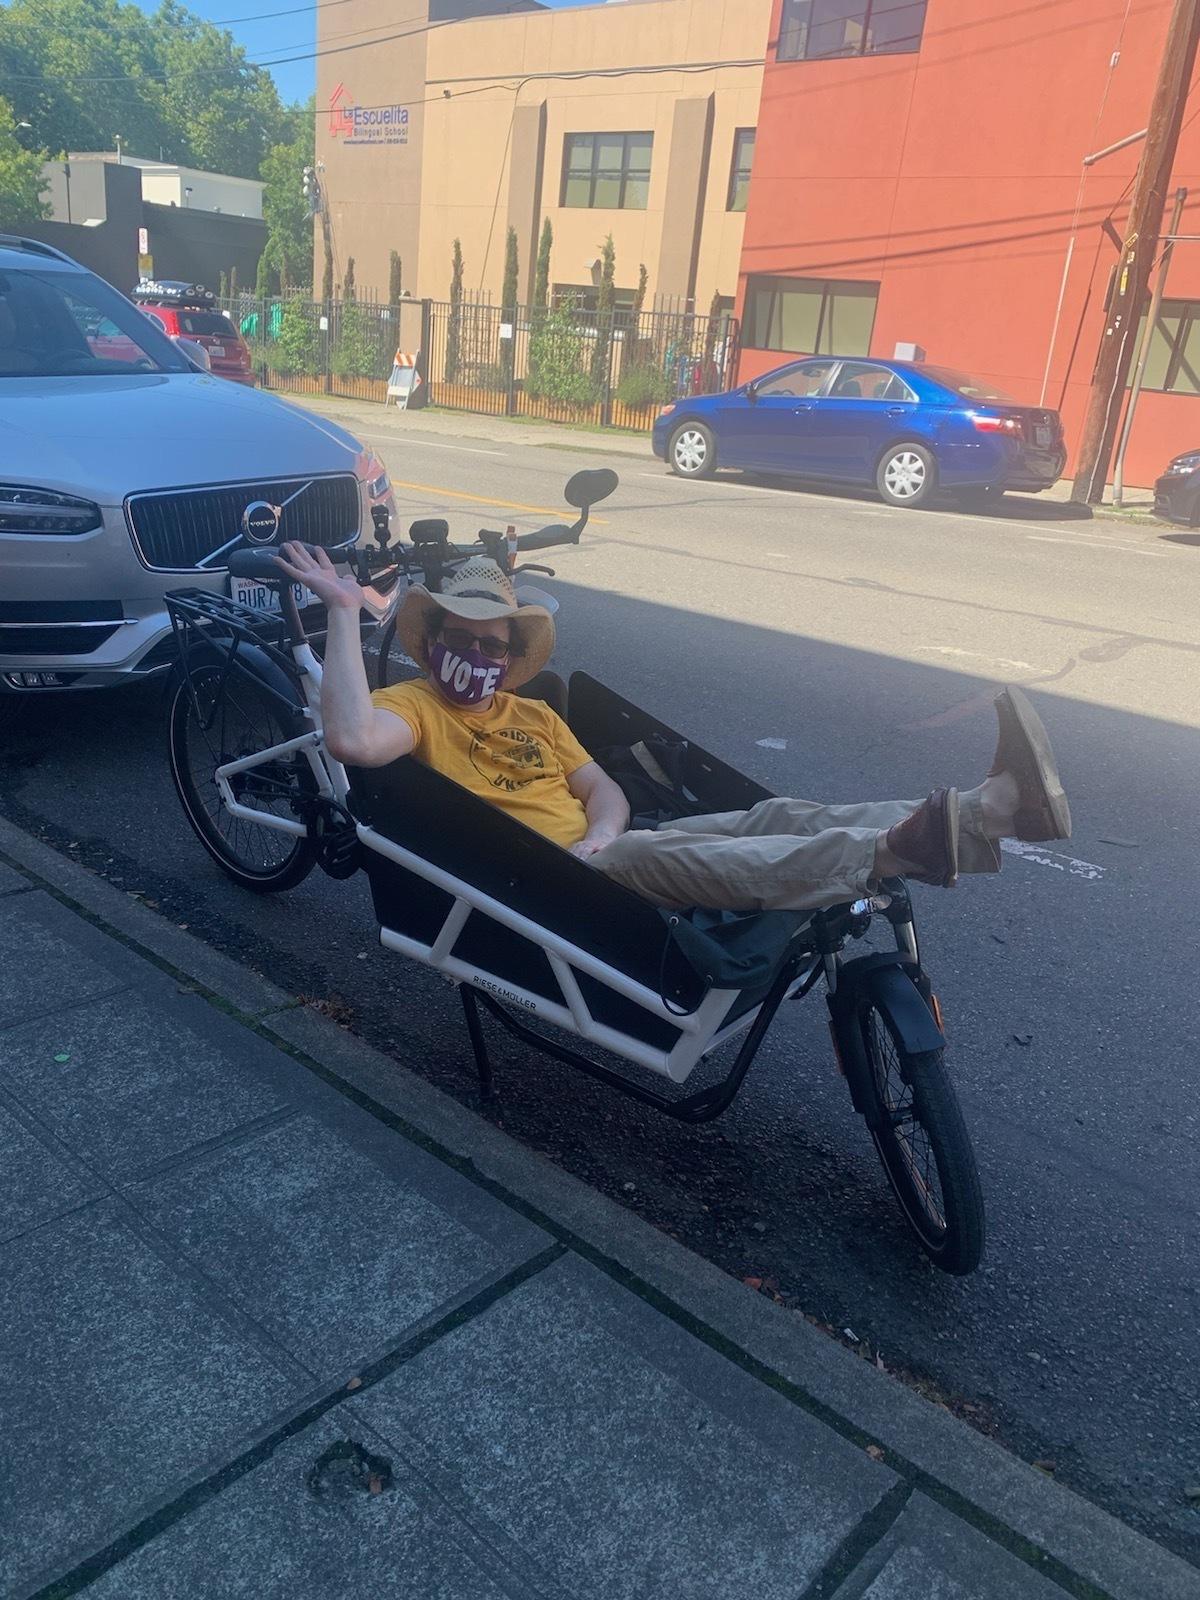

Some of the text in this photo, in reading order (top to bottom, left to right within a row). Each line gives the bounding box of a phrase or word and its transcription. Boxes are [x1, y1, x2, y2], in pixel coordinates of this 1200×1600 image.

[343, 105, 409, 126] La Escuelita
[353, 127, 408, 138] Bilingual School
[250, 519, 275, 527] VOLVO
[440, 650, 501, 698] VOTE
